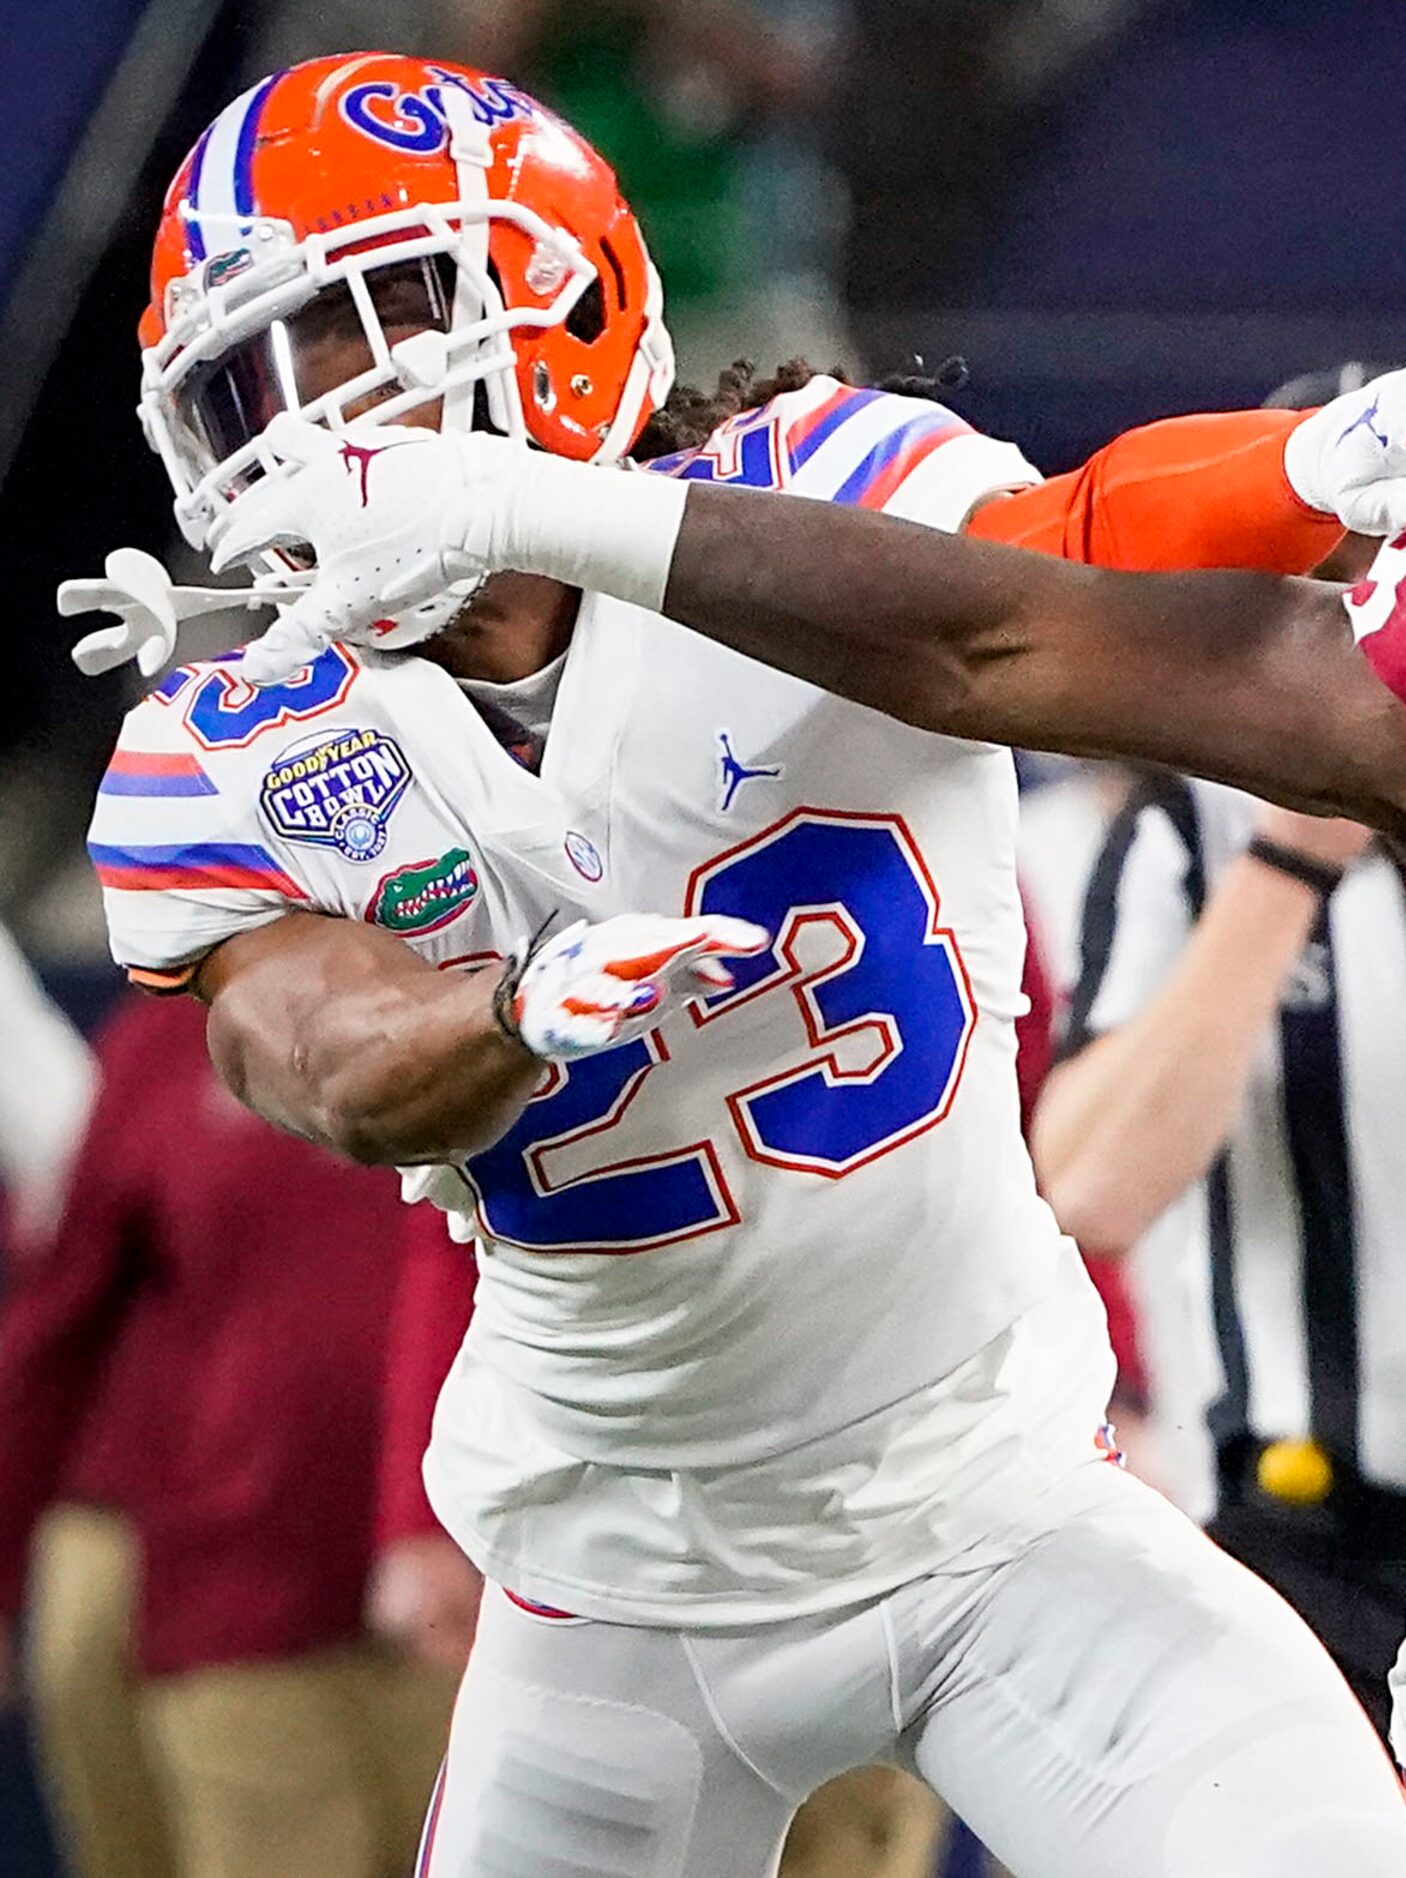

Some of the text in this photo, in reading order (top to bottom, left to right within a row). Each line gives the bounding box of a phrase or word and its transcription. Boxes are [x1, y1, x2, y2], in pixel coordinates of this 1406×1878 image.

[267, 731, 376, 788] GOODYEAR
[272, 744, 401, 827] COTTON
[304, 779, 385, 828] BOWL
